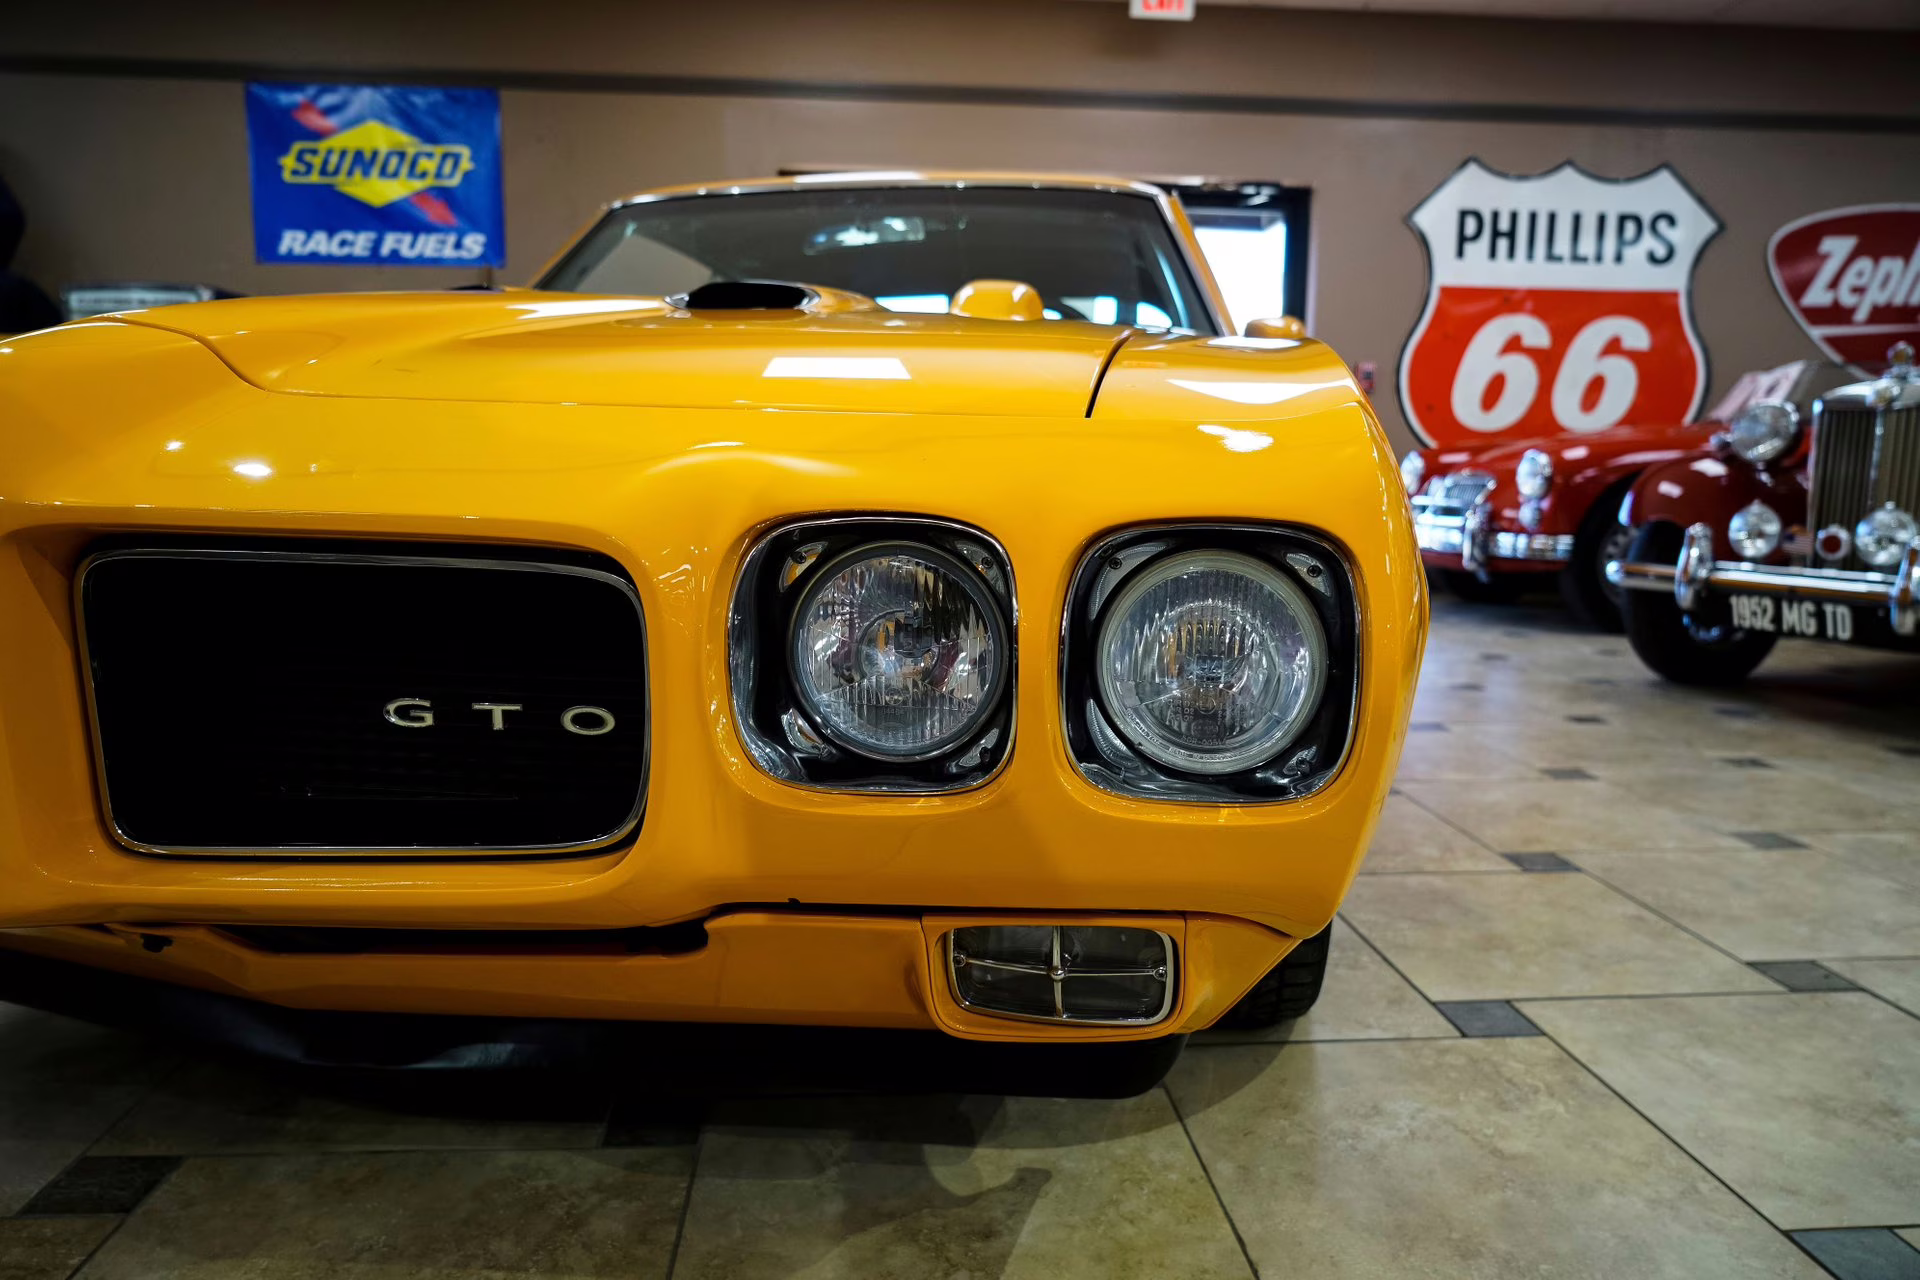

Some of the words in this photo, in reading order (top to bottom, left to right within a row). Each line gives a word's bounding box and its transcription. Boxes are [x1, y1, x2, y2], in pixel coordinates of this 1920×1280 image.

[290, 147, 465, 181] SUNOCO
[278, 229, 377, 257] RACE
[379, 230, 487, 260] FUELS
[1455, 208, 1679, 266] PHILLIPS
[1799, 234, 1920, 324] Zeph
[1450, 311, 1652, 434] 66
[1729, 595, 1776, 632] 1952
[1781, 599, 1819, 637] MG
[1821, 602, 1854, 641] TD
[382, 697, 617, 736] GTO
